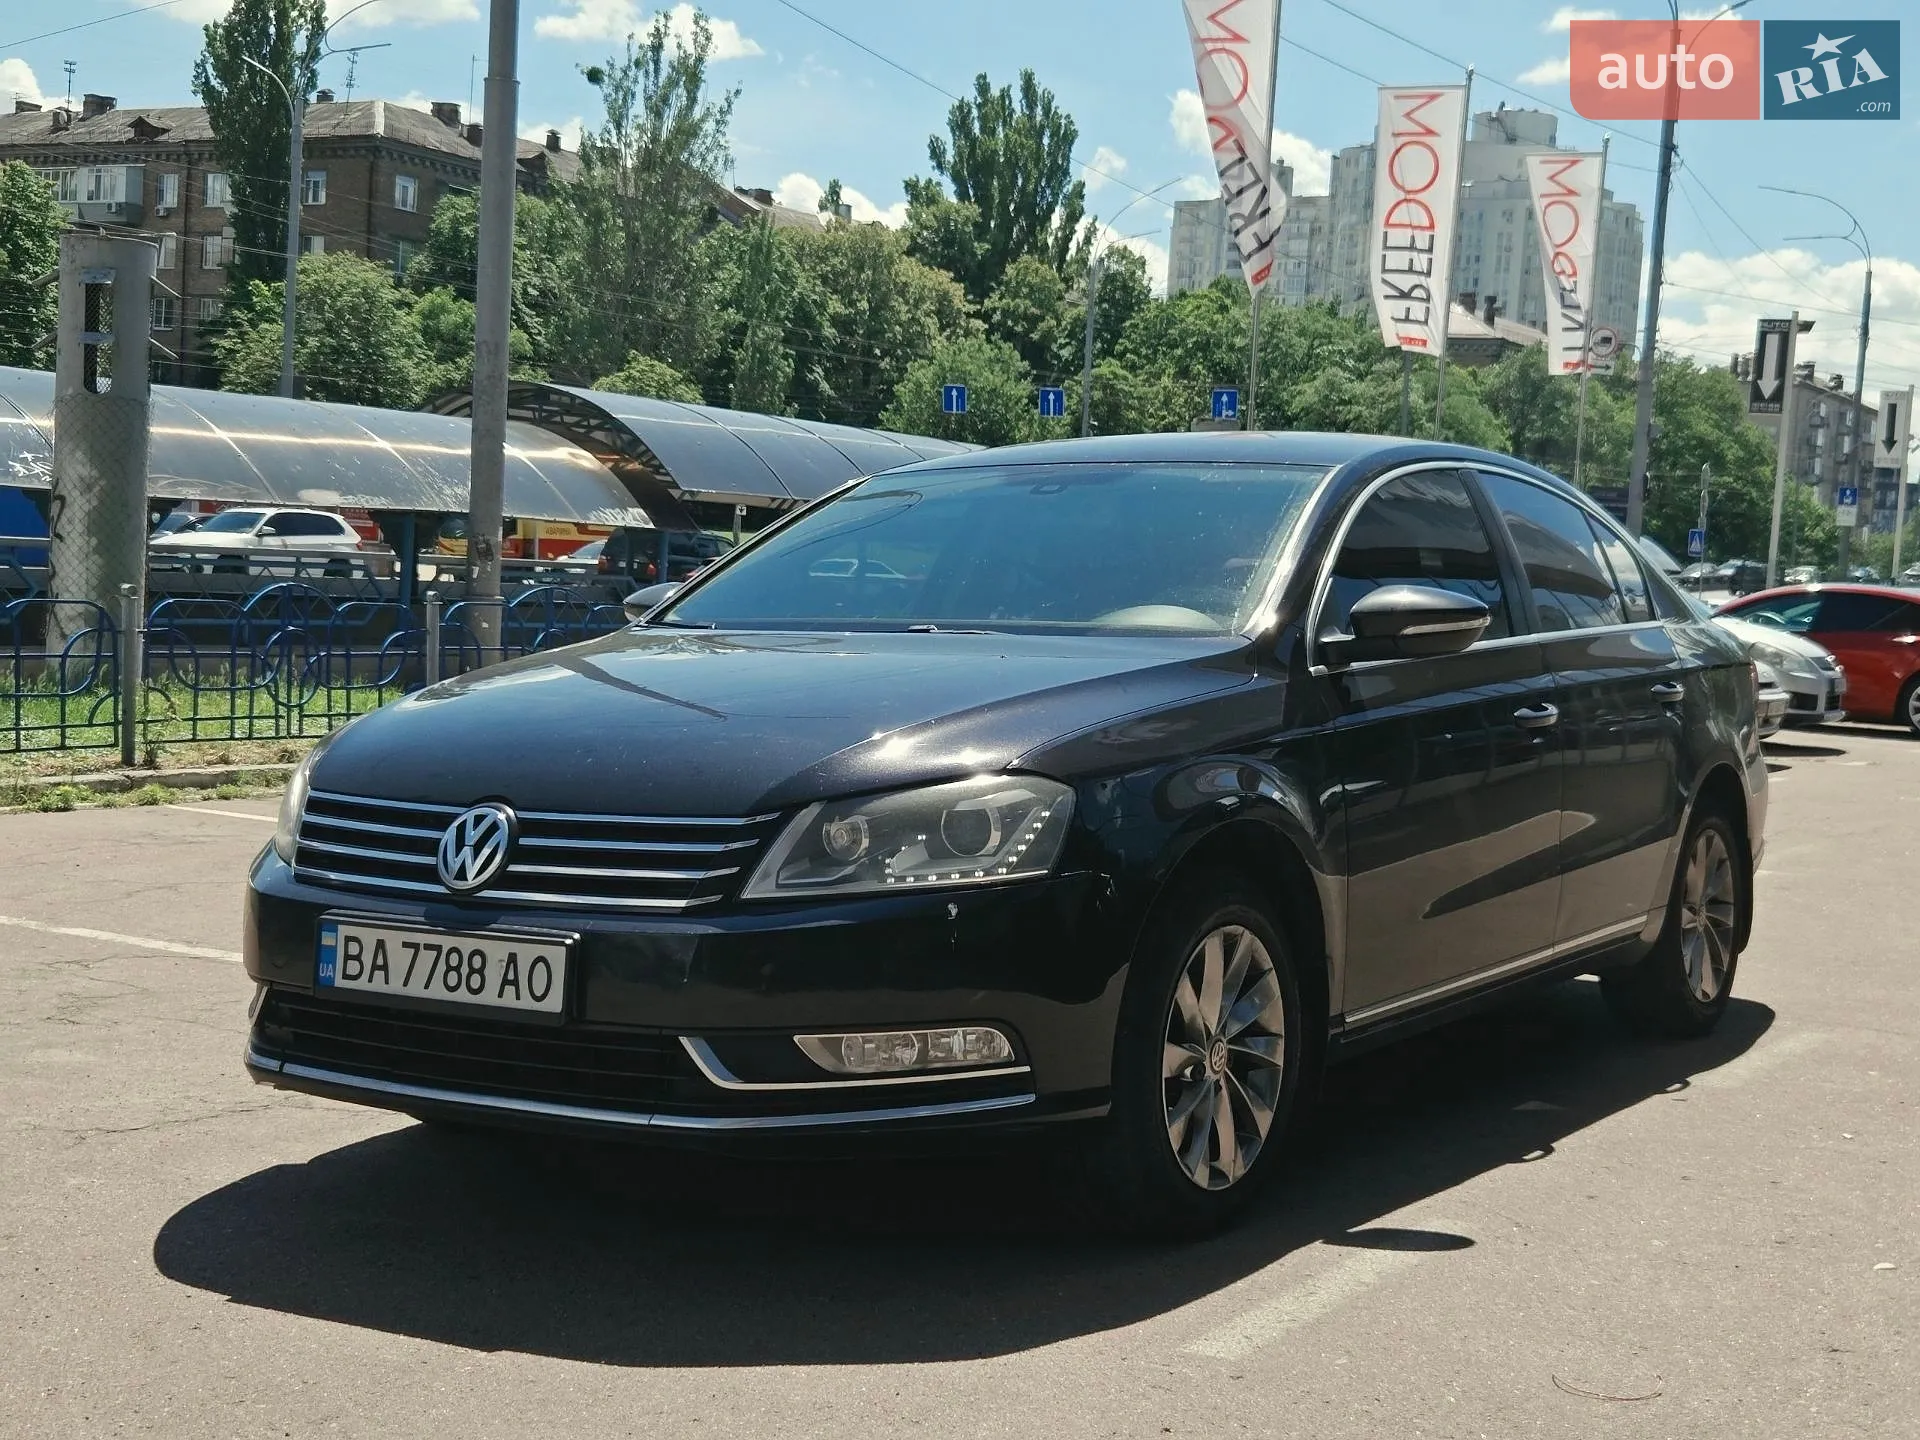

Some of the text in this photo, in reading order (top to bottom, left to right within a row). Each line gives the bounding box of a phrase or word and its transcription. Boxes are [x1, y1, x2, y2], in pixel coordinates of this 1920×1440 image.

[319, 962, 335, 979] UA
[341, 935, 390, 985] BA
[401, 941, 487, 996] 7788
